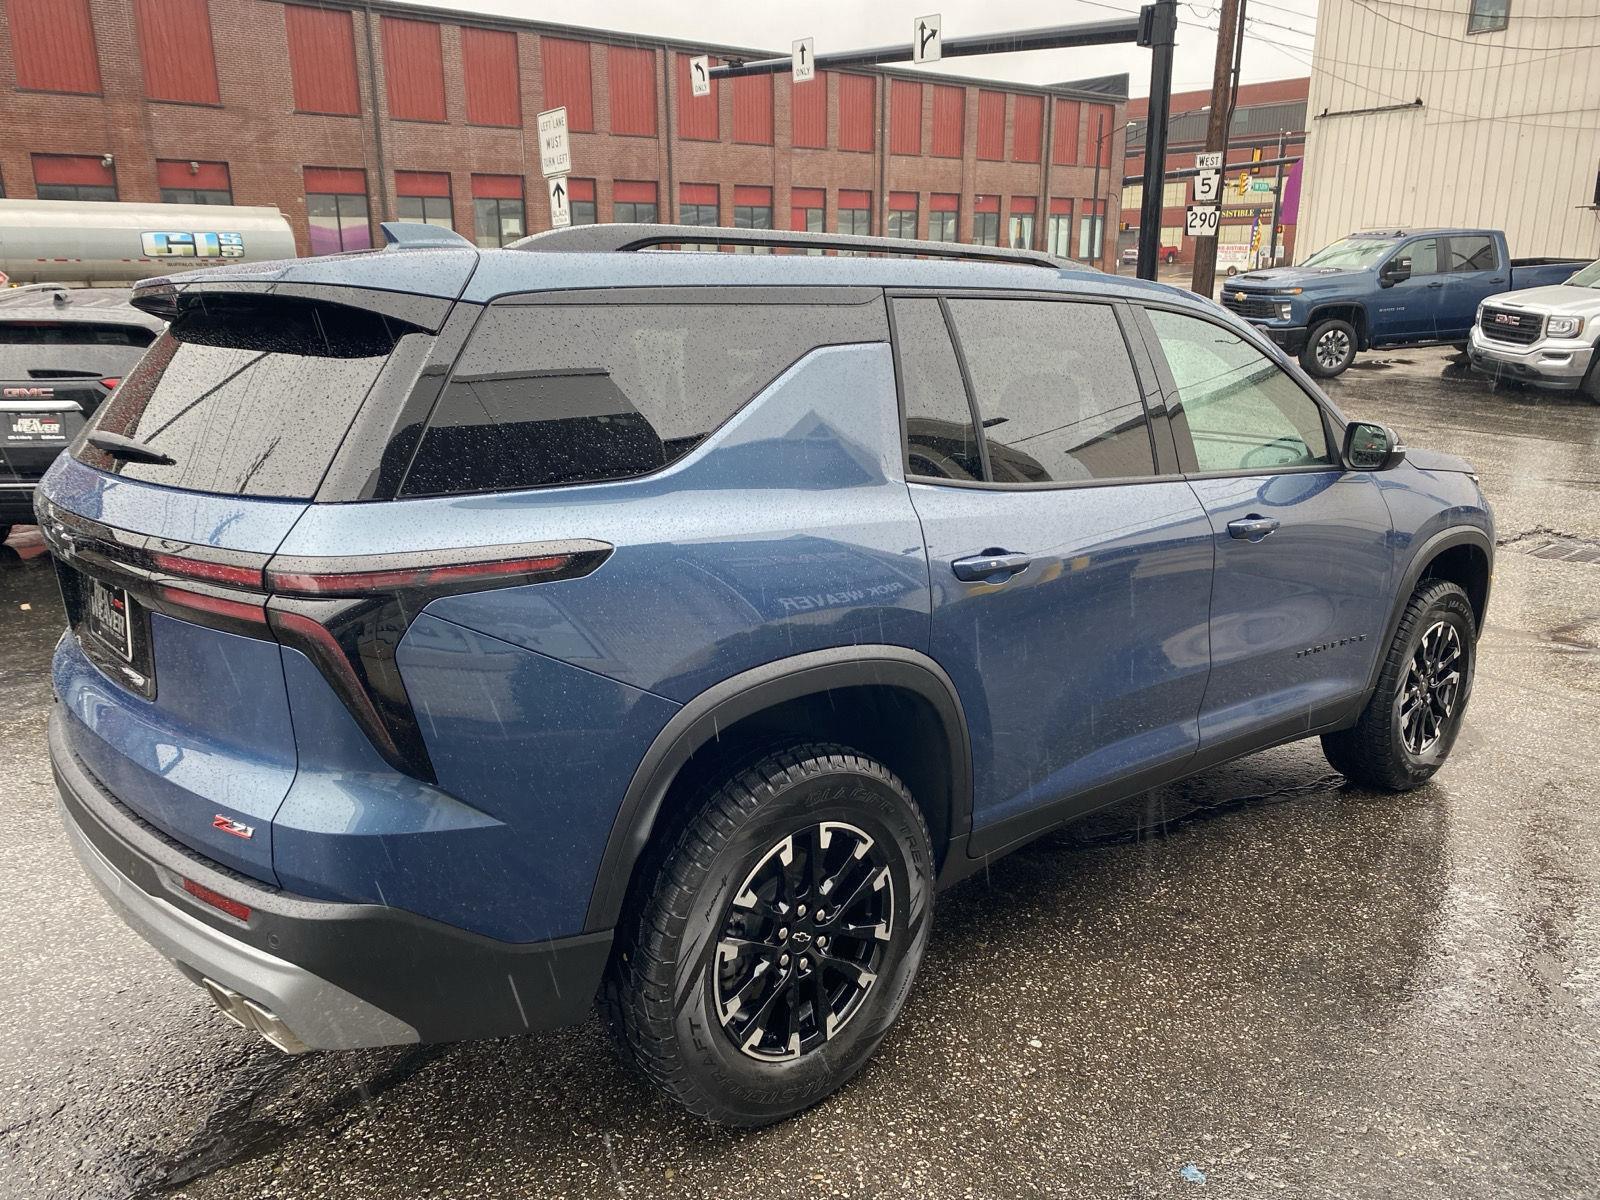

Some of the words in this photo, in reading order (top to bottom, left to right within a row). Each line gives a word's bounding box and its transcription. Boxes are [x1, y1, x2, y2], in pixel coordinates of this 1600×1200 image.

[796, 67, 811, 77] ONLY
[540, 120, 552, 132] LEFT
[552, 116, 566, 129] LANE
[546, 136, 562, 150] MUST
[543, 156, 556, 168] TURN
[556, 153, 568, 165] LEFT
[1199, 156, 1220, 167] WEST
[1200, 177, 1212, 194] 5
[1188, 211, 1217, 229] 290
[1494, 313, 1521, 326] GMC
[3, 387, 55, 398] GMC
[12, 423, 60, 434] WEAVER
[91, 594, 126, 637] WEAVER
